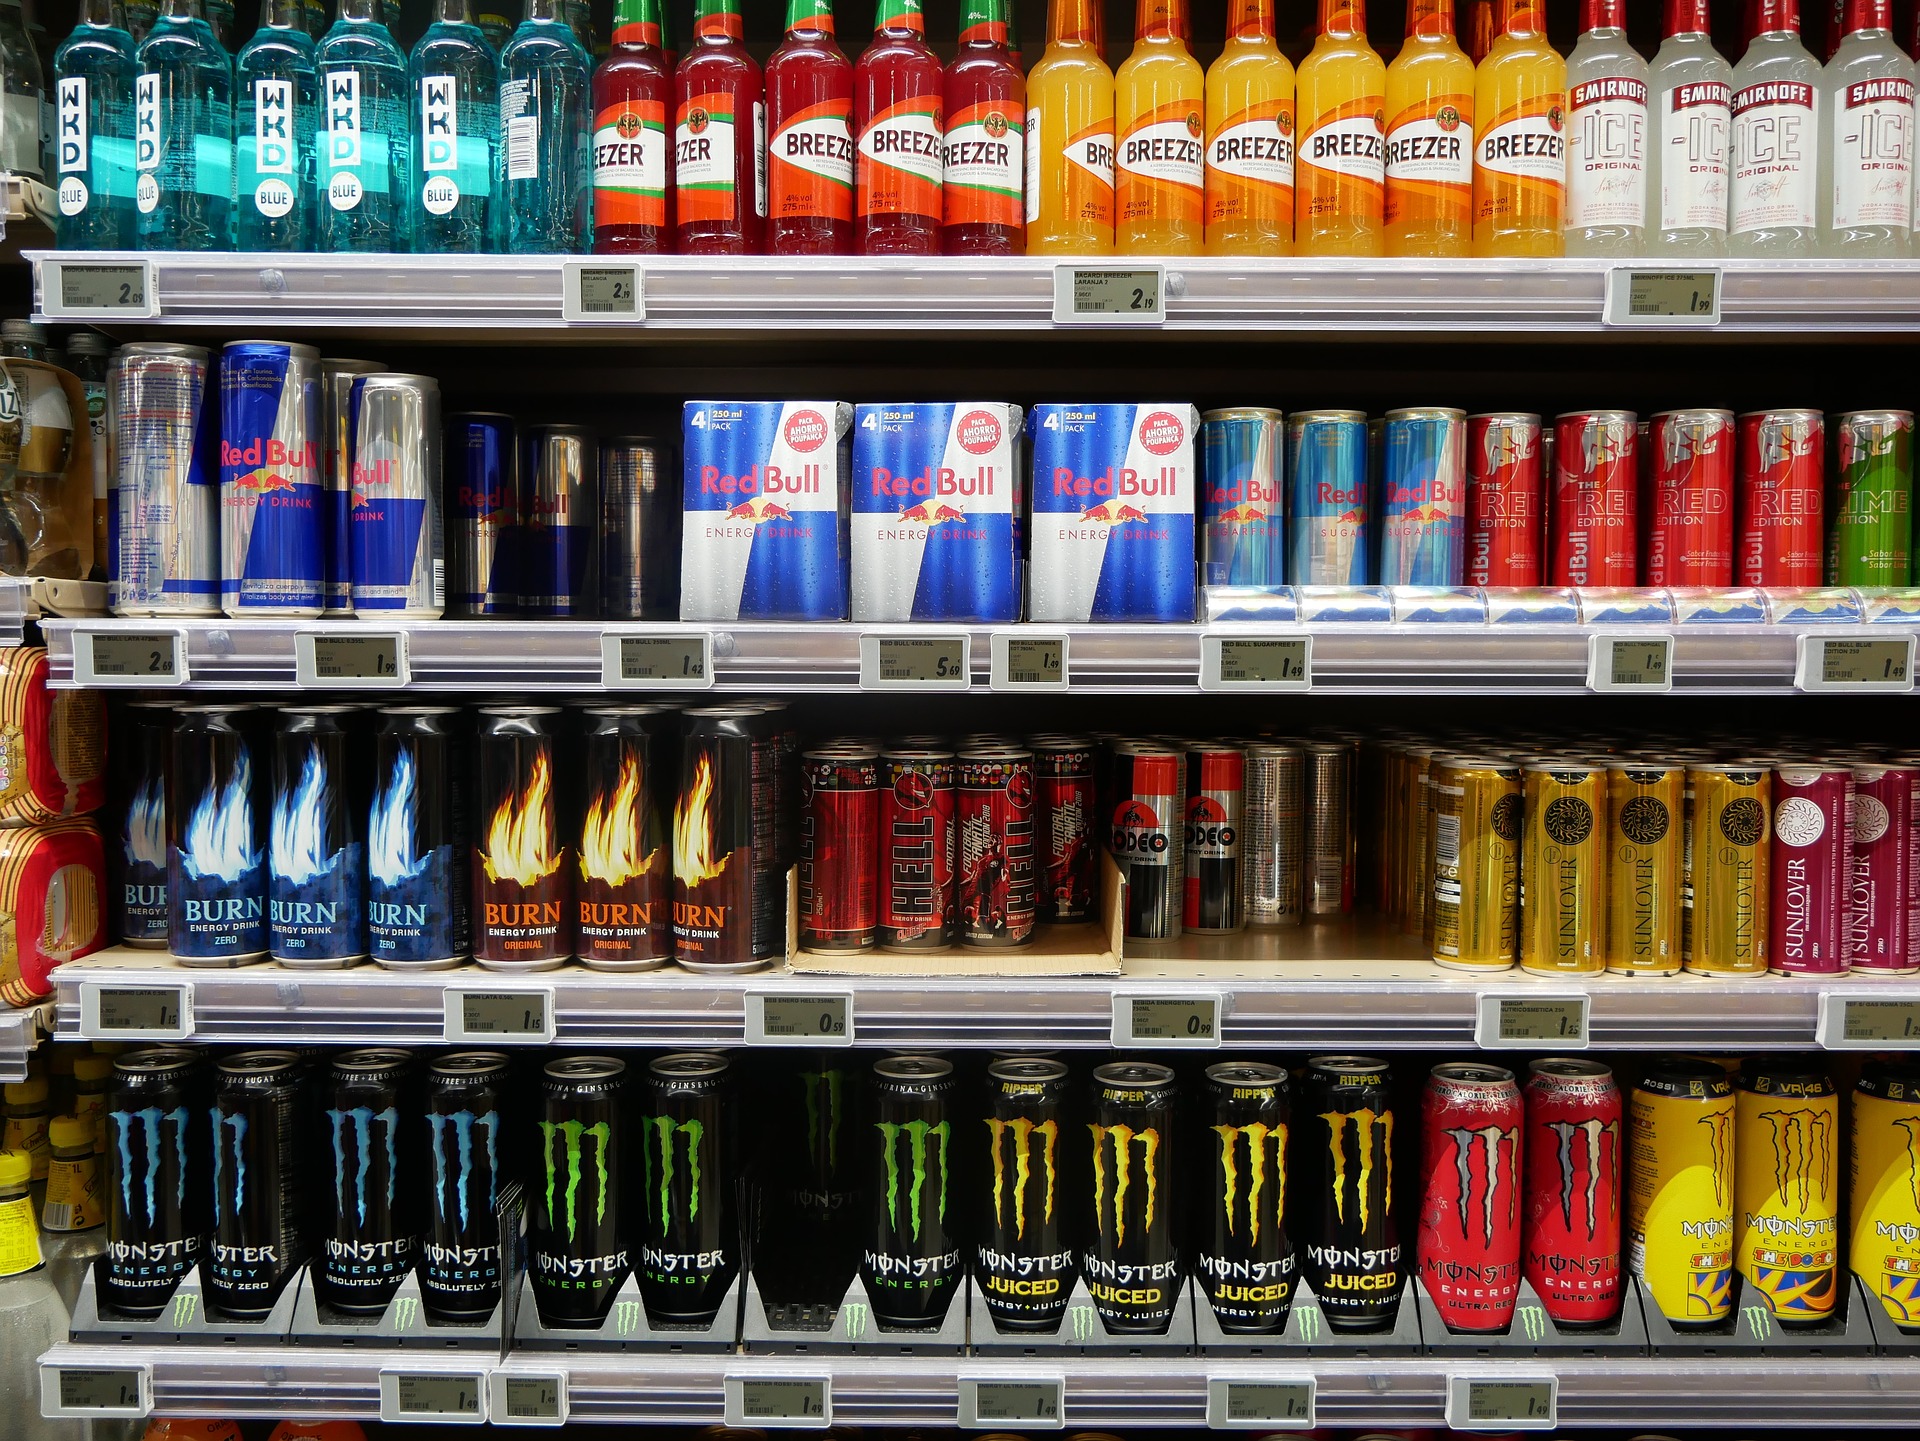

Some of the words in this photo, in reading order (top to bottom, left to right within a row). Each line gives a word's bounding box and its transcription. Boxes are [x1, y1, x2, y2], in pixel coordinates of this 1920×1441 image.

[1575, 84, 1647, 104] SMIRNOFF
[1732, 86, 1808, 112] SMIRNOFF
[63, 85, 81, 164] WKD
[138, 82, 155, 162] WKD
[263, 88, 286, 166] WKD
[332, 79, 354, 159] WKD
[428, 84, 451, 163] WKD
[1584, 112, 1644, 160] ICE
[1735, 115, 1801, 168] ICE
[786, 133, 853, 161] BREEZE
[1126, 137, 1202, 165] BREEZER
[1217, 136, 1292, 163] BREEZER
[1385, 137, 1461, 166] BREEZER
[1485, 133, 1564, 160] BREEZER
[1585, 163, 1642, 171] ORIGINAL
[1736, 164, 1799, 179] ORIGINAL
[61, 189, 82, 203] BLUE
[138, 188, 155, 201] BLUE
[261, 192, 288, 205] BLUE
[332, 185, 356, 198] BLUE
[427, 187, 453, 202] BLUE
[786, 194, 799, 203] 4%
[800, 194, 812, 202] vol
[782, 203, 797, 212] 275
[1312, 196, 1324, 205] 4%
[1325, 195, 1338, 203] vol
[1308, 205, 1323, 214] 275
[1324, 204, 1334, 213] ml
[691, 411, 705, 430] 4
[713, 410, 729, 418] 250
[731, 410, 742, 418] ml
[790, 425, 823, 435] AHORRO
[790, 434, 823, 444] POUPANÇA
[963, 435, 996, 445] POUPANÇA
[221, 439, 261, 467] Red
[266, 439, 318, 467] Bull
[701, 466, 758, 494] Red
[764, 465, 819, 494] Bull
[871, 466, 931, 495] Red
[936, 466, 994, 495] Bull
[1053, 467, 1113, 495] Red
[1119, 467, 1176, 495] Bull
[1206, 482, 1242, 502] Red
[1246, 480, 1282, 502] Bull
[223, 497, 266, 508] ENERGY
[271, 497, 312, 508] DRINK
[1657, 489, 1727, 514] RED
[1657, 516, 1703, 525] EDITION
[706, 527, 762, 538] ENERGY
[768, 528, 813, 538] DRINK
[878, 530, 936, 540] ENERGY
[941, 530, 987, 540] DRINK
[1059, 530, 1117, 540] ENERGY
[1122, 530, 1168, 540] DRINK
[268, 593, 285, 602] body
[972, 815, 984, 861] FANATIC
[962, 821, 973, 874] FOOTBALL
[891, 816, 934, 914] HELL
[185, 896, 263, 922] BURN
[271, 901, 337, 924] BURN
[1559, 857, 1577, 957] SUNLOVER
[1635, 857, 1653, 956] SUNLOVER
[1736, 858, 1753, 957] SUNLOVER
[1786, 857, 1805, 958] SUNLOVER
[1853, 855, 1870, 954] SUNLOVER
[369, 903, 426, 925] BURN
[485, 901, 562, 926] BURN
[580, 903, 651, 927] BURN
[190, 924, 229, 932] ENERGY
[233, 921, 260, 930] DRINK
[272, 926, 298, 934] ENERGY
[301, 926, 332, 934] DRINK
[489, 928, 526, 936] ENERGY
[530, 926, 557, 936] DRINK
[582, 928, 614, 937] ENERGY
[617, 927, 647, 936] DRINK
[215, 936, 237, 945] ZERO
[286, 938, 305, 948] ZERO
[504, 941, 543, 950] ORIGINAL
[594, 940, 630, 949] ORIGINAL
[577, 1083, 620, 1093] GINSENG
[1340, 1074, 1381, 1086] RIPPER
[1644, 1078, 1675, 1091] ROSSI
[1002, 1083, 1043, 1094] RIPPER
[1103, 1088, 1144, 1102] RIPPER
[1233, 1087, 1274, 1100] RIPPER
[1764, 1237, 1834, 1248] ENERGY
[865, 1248, 960, 1277] MONSTER
[978, 1243, 1073, 1276] MONSTER
[1754, 1249, 1786, 1262] THE
[113, 1259, 197, 1274] ENERGY
[1082, 1253, 1177, 1283] MONSTER
[1200, 1253, 1295, 1281] MONSTER
[109, 1277, 173, 1288] ABSOLUTELY
[238, 1281, 269, 1290] ZERO
[876, 1275, 953, 1288] ENERGY
[986, 1276, 1059, 1296] JUICED
[1325, 1272, 1396, 1290] JUICED
[1088, 1288, 1161, 1305] JUICED
[1215, 1284, 1288, 1302] JUICED
[1442, 1285, 1517, 1297] ENERGY
[1449, 1301, 1490, 1310] ULTRA
[1496, 1300, 1512, 1309] RED
